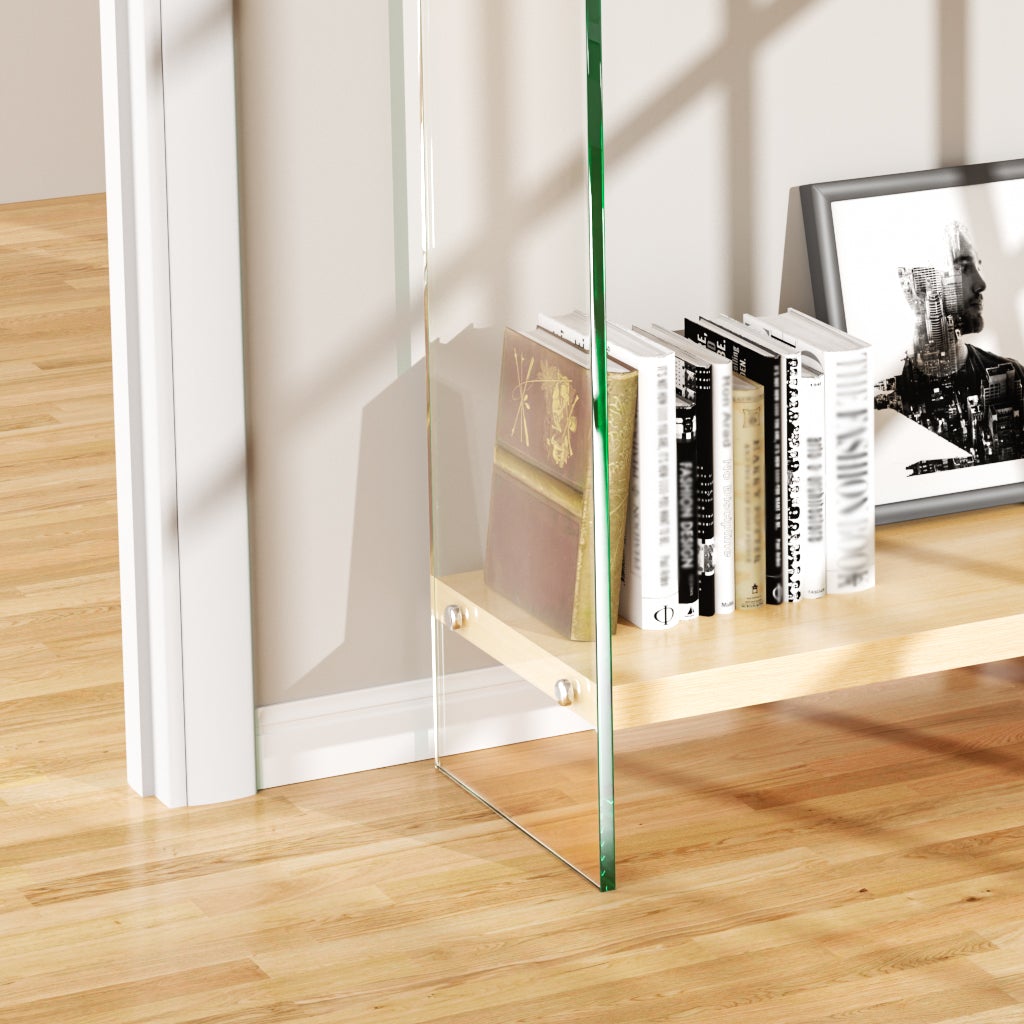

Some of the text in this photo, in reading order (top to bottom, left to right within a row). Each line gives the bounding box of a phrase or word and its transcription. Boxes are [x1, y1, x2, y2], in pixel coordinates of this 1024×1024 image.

[722, 412, 732, 448] Arad
[836, 408, 869, 515] FASHION
[679, 461, 693, 519] FASHION
[679, 521, 694, 569] DESIGN
